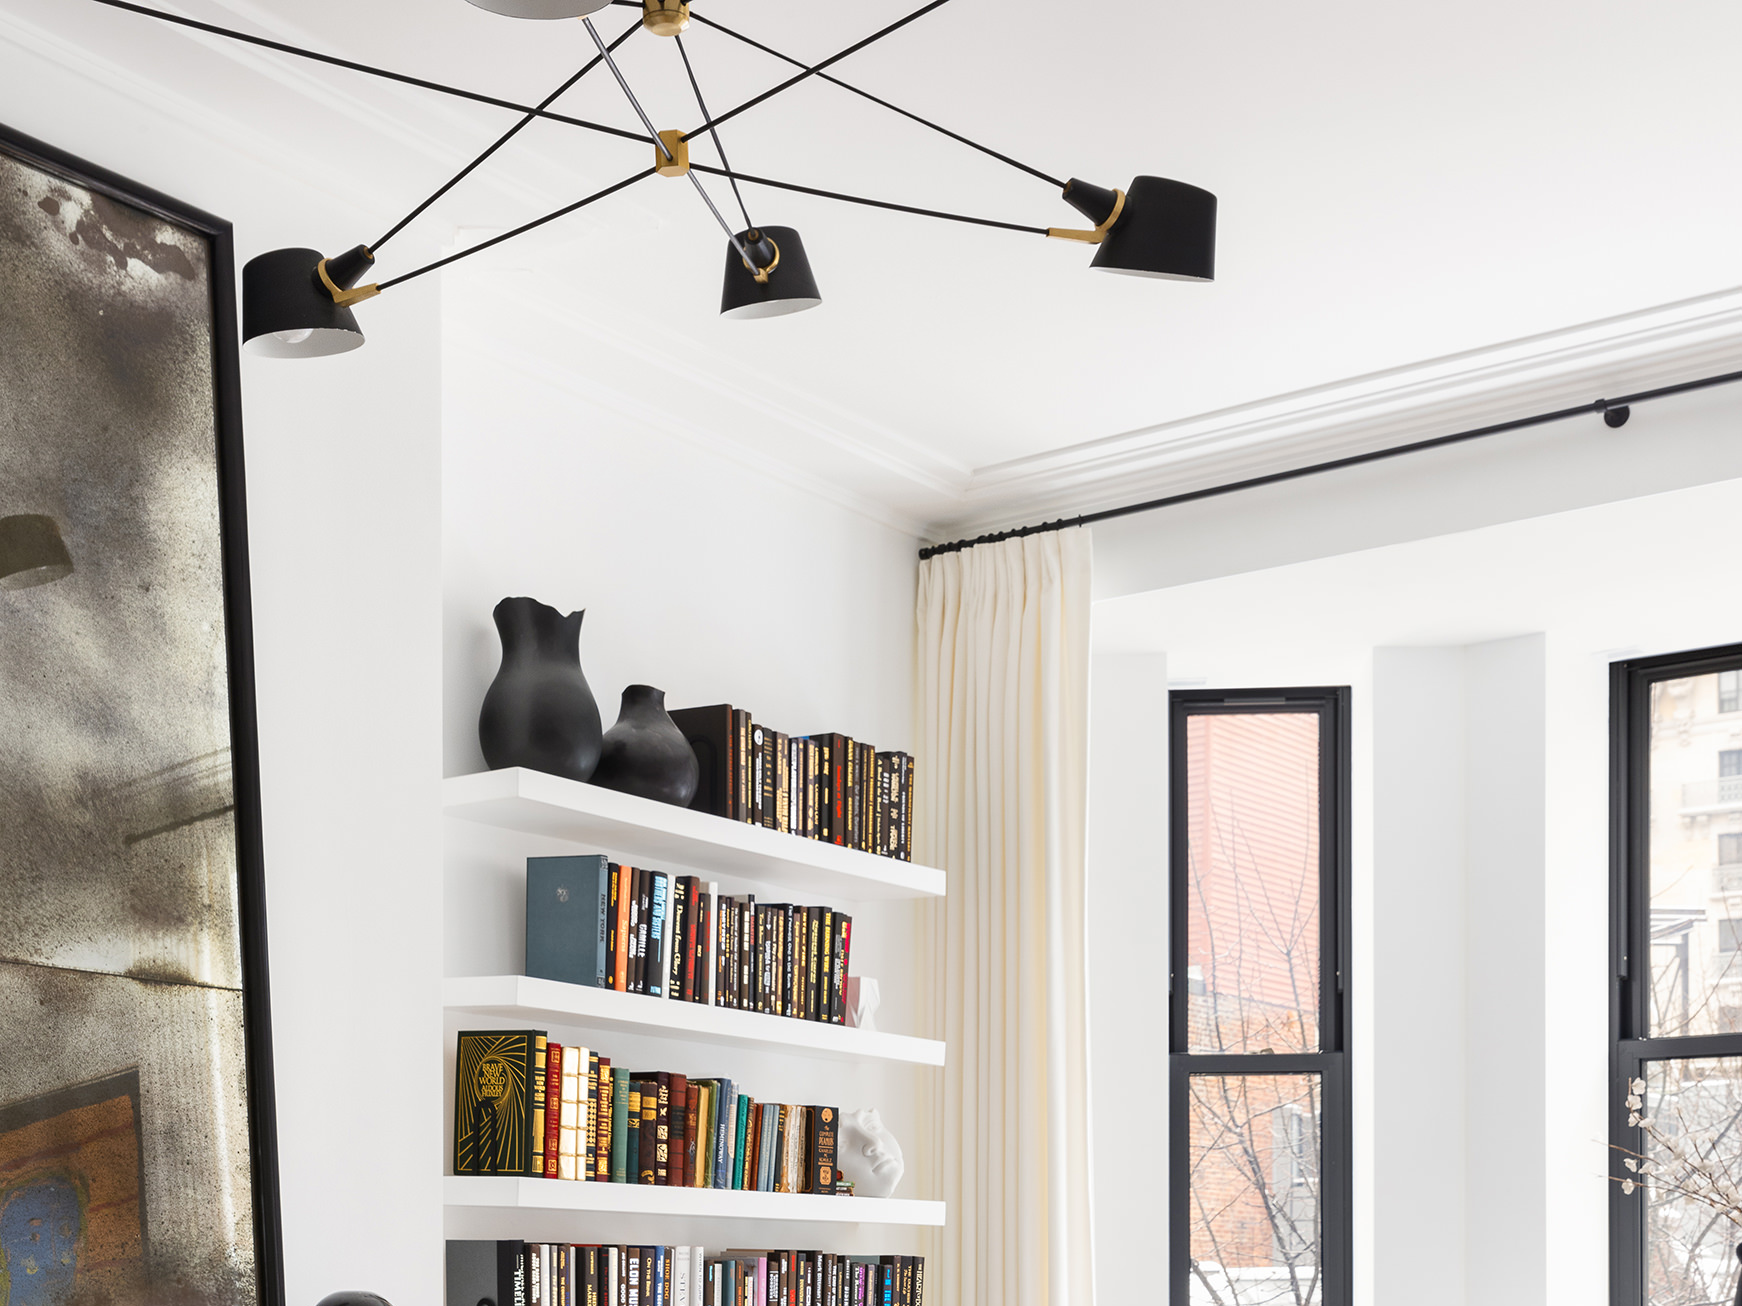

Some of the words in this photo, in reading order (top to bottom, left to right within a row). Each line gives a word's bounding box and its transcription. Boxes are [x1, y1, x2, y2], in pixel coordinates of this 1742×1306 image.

[676, 904, 684, 934] Descent
[620, 920, 628, 952] Sapiens
[638, 924, 648, 958] CAMILLE
[674, 934, 683, 954] from
[672, 953, 681, 976] Glory
[479, 1076, 505, 1085] WORLD
[482, 1063, 503, 1073] BRAVE
[718, 1124, 726, 1164] HEMINGWAY
[628, 1258, 640, 1286] ELON
[916, 1270, 924, 1296] HEART
[884, 1290, 892, 1302] THE
